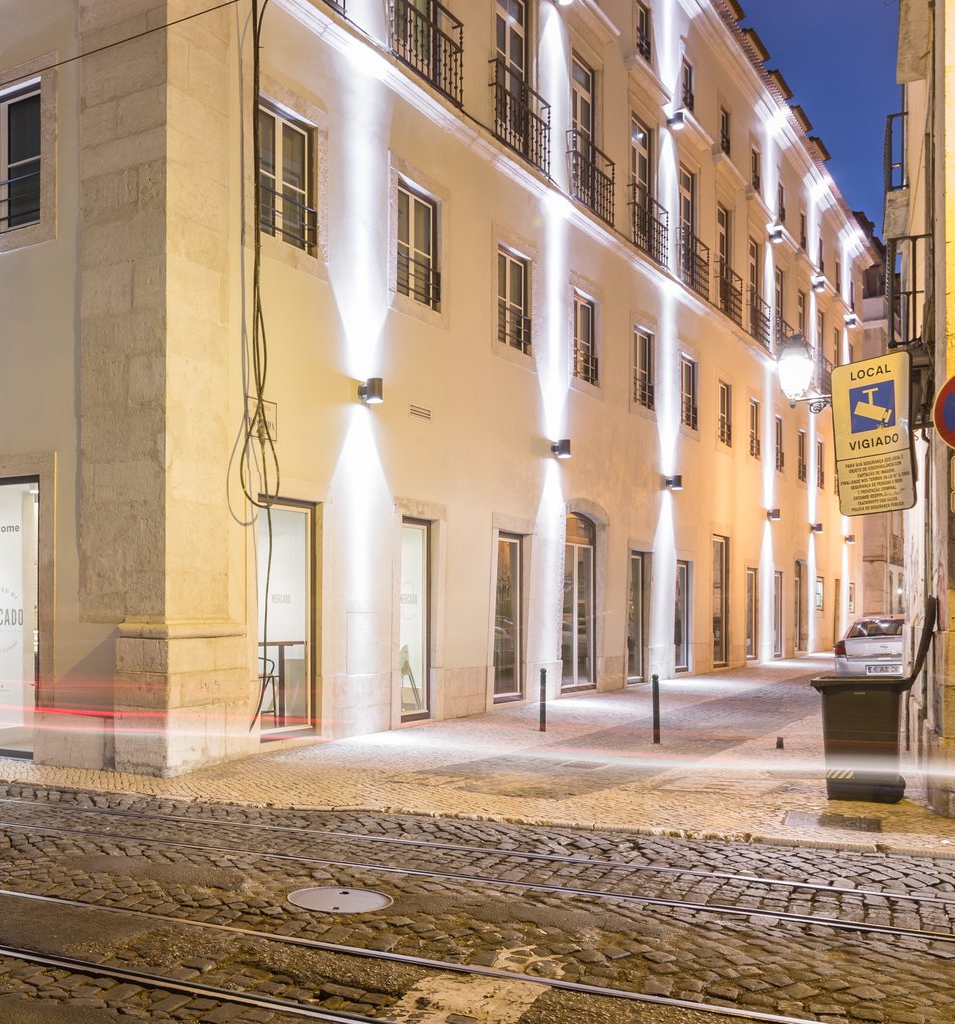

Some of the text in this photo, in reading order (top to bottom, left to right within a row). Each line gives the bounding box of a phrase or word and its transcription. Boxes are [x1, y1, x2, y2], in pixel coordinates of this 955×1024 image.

[850, 364, 891, 381] LOCAL
[849, 433, 899, 451] VIGIADO
[271, 594, 291, 604] MERCADO
